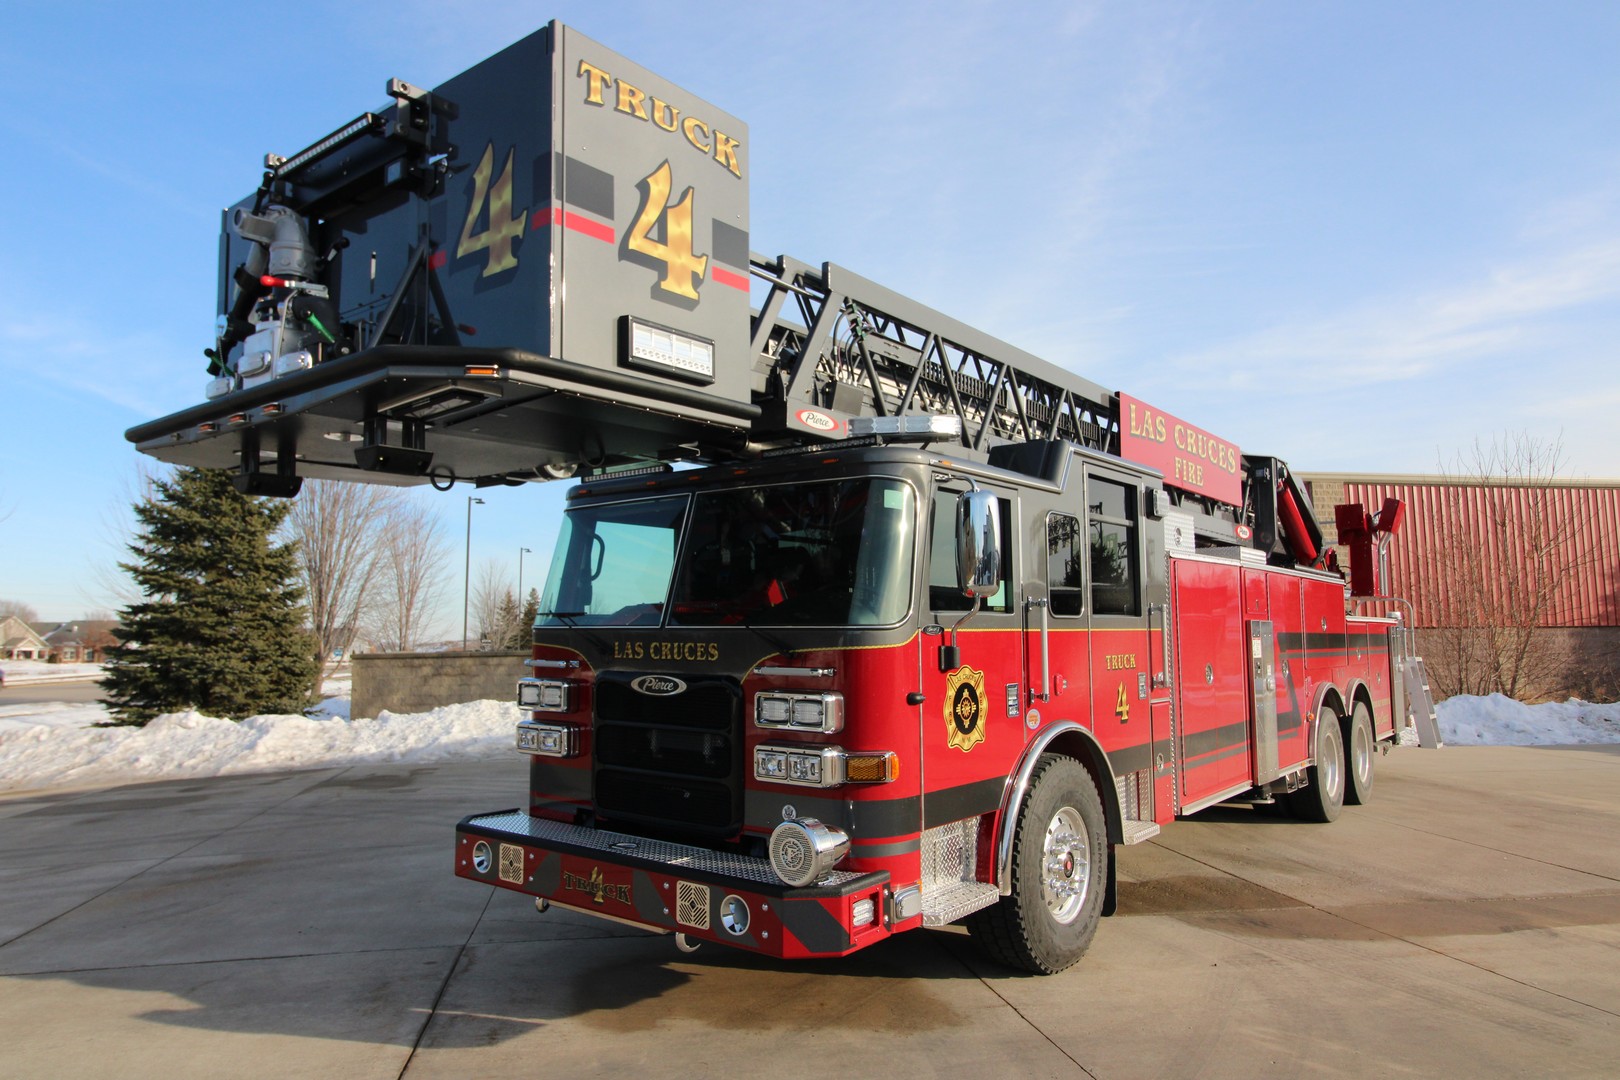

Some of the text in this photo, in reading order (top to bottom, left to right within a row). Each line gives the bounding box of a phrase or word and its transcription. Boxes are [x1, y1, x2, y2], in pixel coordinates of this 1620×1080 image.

[577, 59, 742, 179] TRUCK
[453, 139, 528, 282] 4
[620, 158, 709, 308] 4
[805, 412, 830, 428] Pierce
[1129, 403, 1236, 474] LAS CRUCES
[1175, 457, 1204, 487] FIRE
[614, 641, 719, 661] LAS CRUCES
[1105, 653, 1136, 670] TRUCK
[642, 677, 675, 691] Pierce
[1115, 681, 1130, 723] 4
[563, 871, 631, 905] TRUCK
